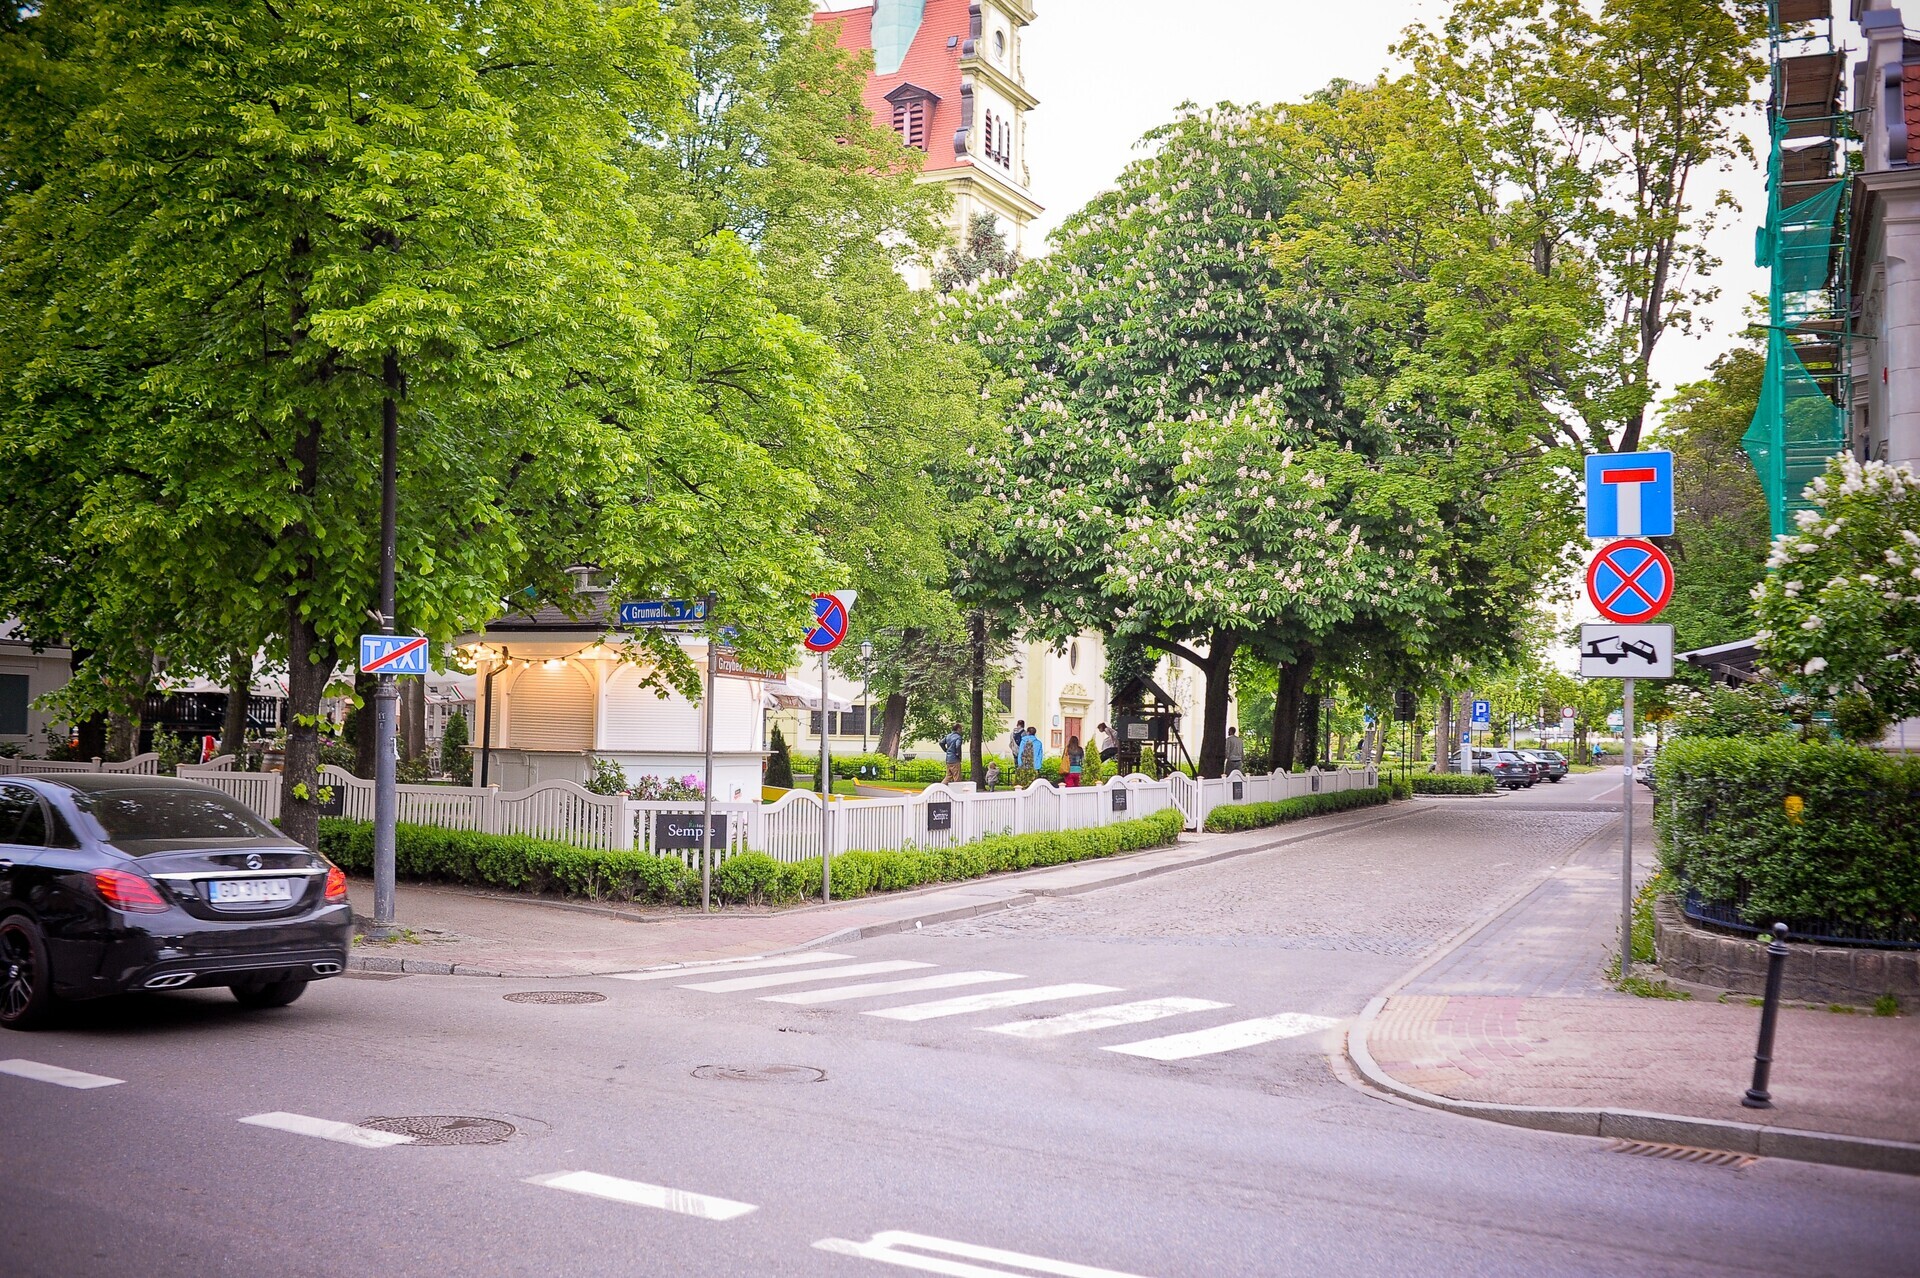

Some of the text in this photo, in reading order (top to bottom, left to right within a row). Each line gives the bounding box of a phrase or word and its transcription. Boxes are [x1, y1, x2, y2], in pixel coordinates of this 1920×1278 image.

[364, 640, 424, 670] TAXI
[1476, 703, 1486, 716] P
[668, 823, 716, 841] Sempe
